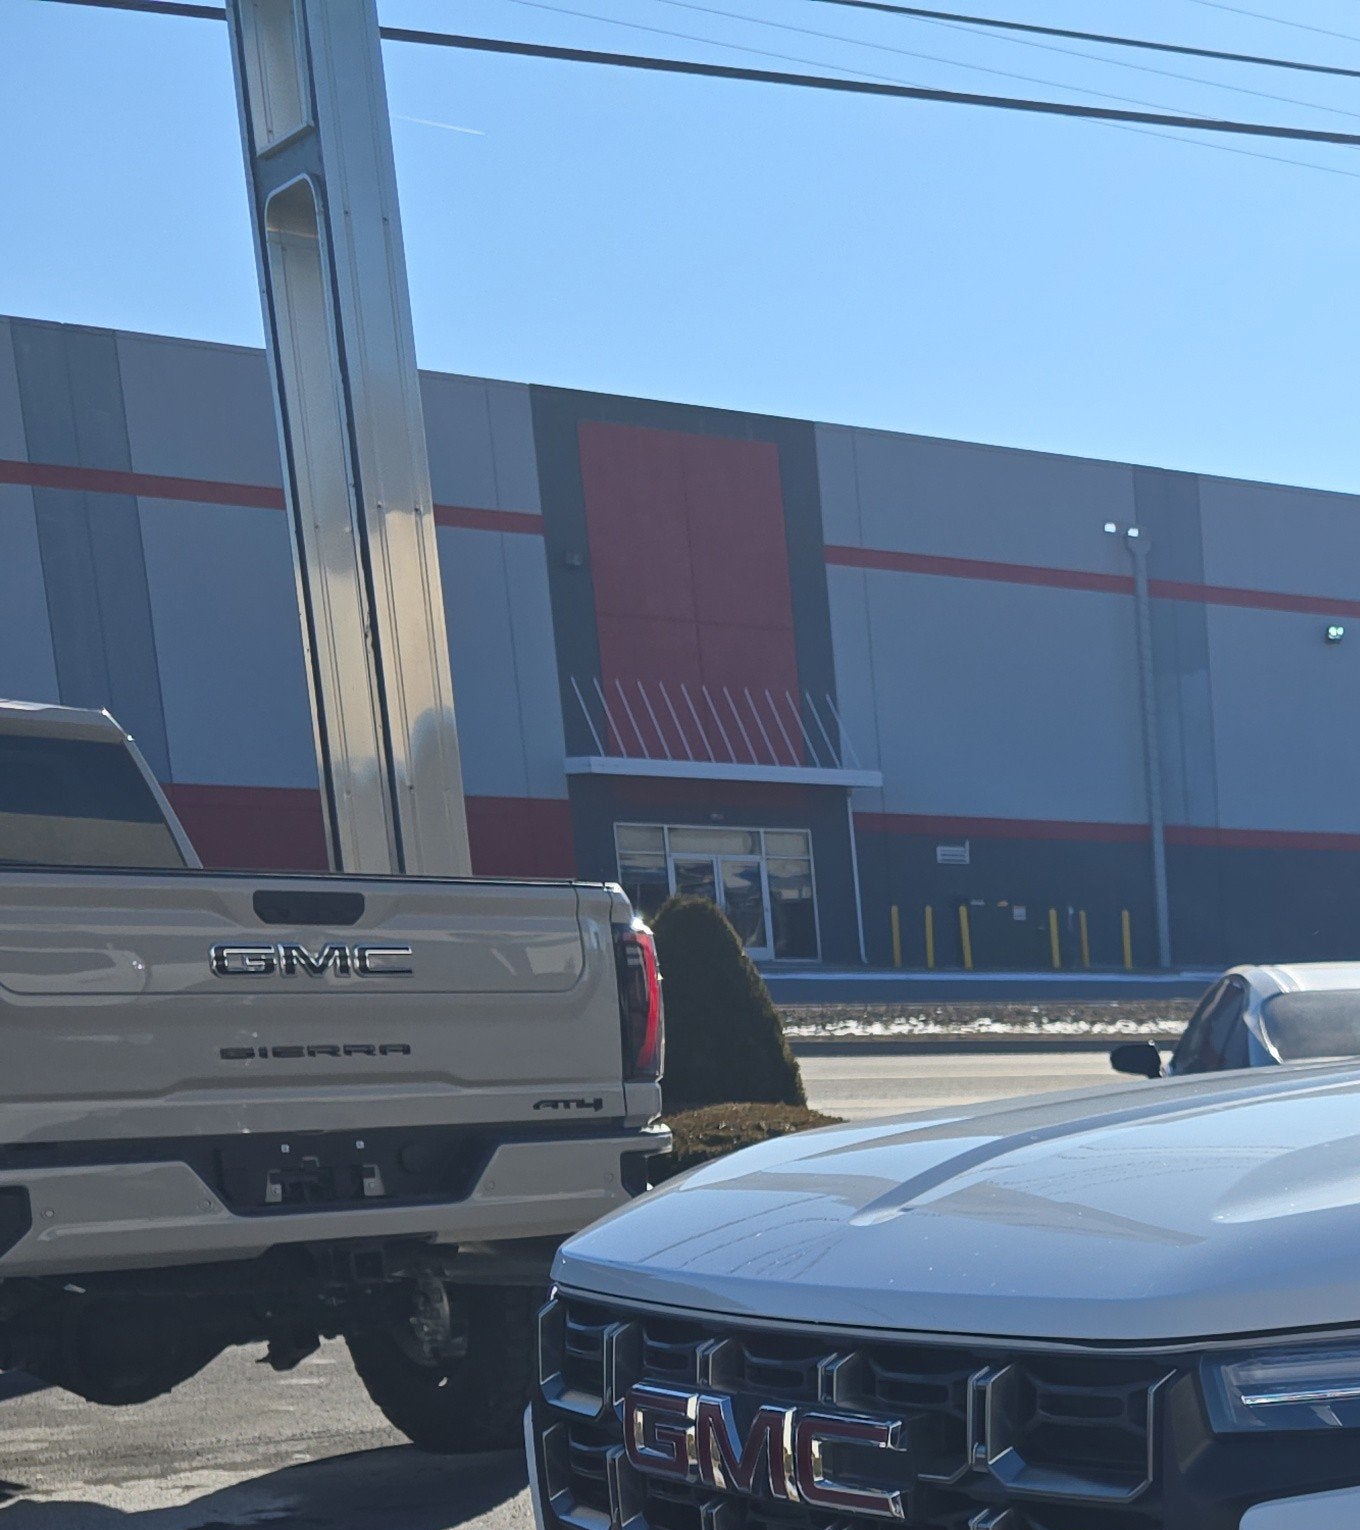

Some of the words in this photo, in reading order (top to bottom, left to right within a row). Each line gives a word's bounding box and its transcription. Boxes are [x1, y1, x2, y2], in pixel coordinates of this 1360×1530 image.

[209, 942, 414, 978] GMC
[219, 1043, 411, 1061] SIERRA
[532, 1097, 603, 1112] AT4
[622, 1381, 906, 1519] GMC
